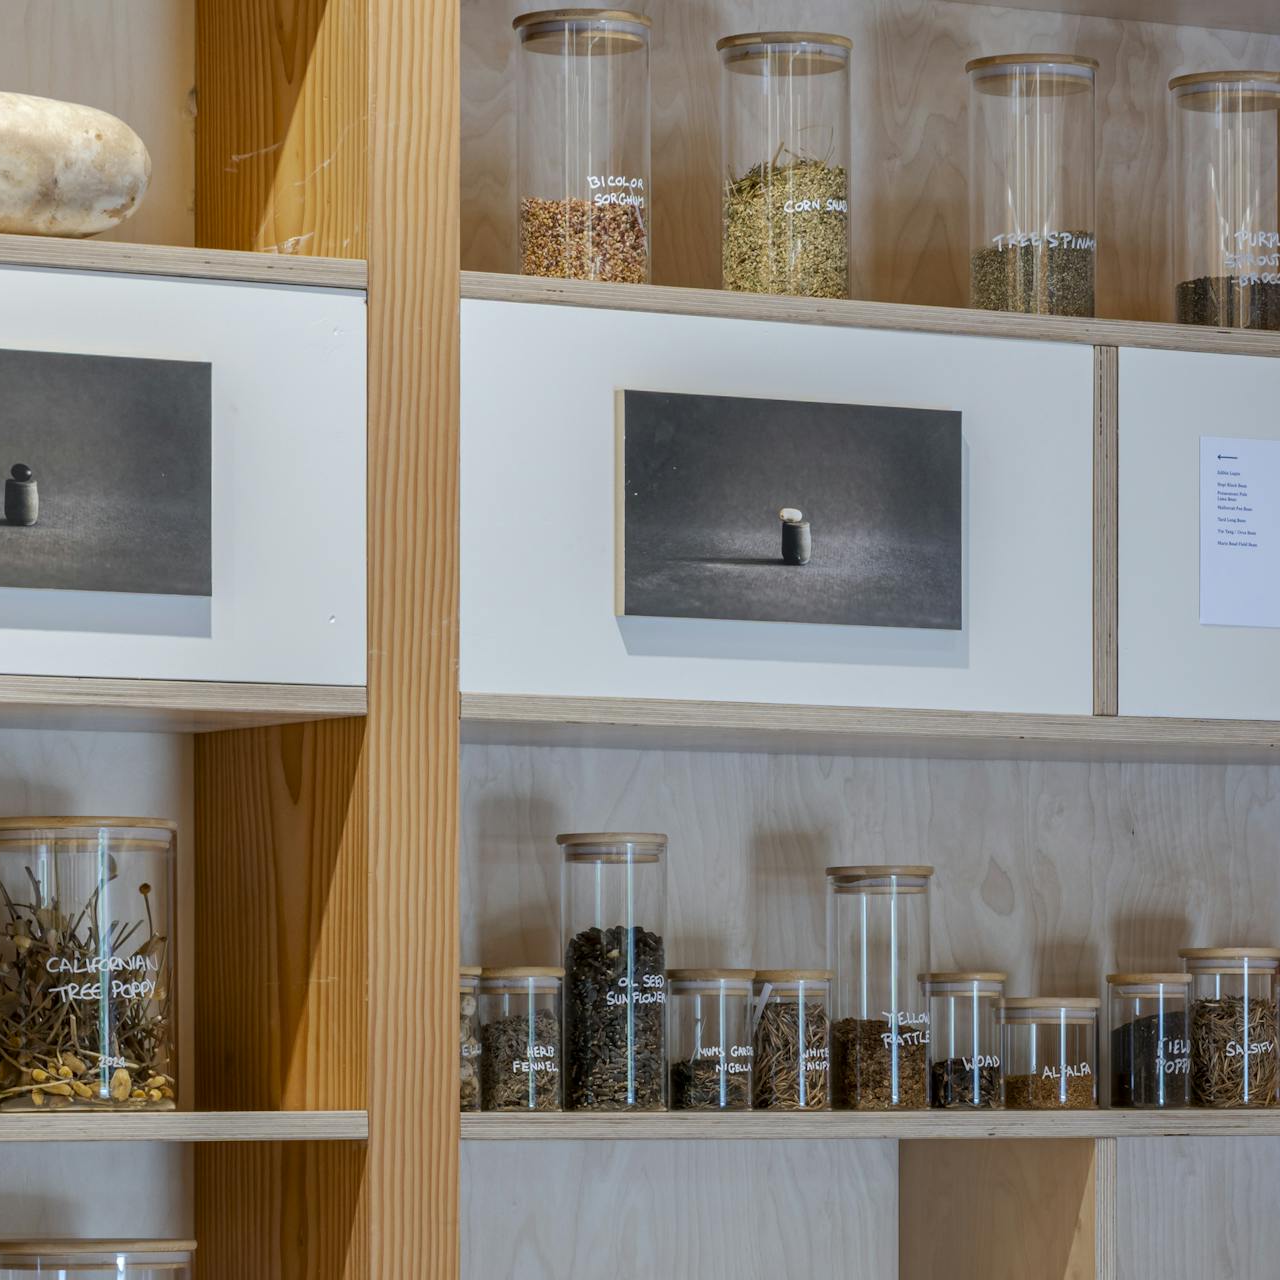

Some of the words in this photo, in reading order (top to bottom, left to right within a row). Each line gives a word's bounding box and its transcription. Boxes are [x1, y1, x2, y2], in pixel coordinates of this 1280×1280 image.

[587, 175, 644, 190] BICOLOR
[784, 200, 819, 213] CORN
[992, 231, 1042, 252] TREE
[46, 954, 159, 974] CALIFORNIAN
[48, 982, 104, 1003] TREE
[111, 979, 156, 999] POPPY
[526, 1046, 555, 1059] HERB
[1225, 1040, 1274, 1057] SALSIFY
[513, 1060, 559, 1073] FENNEL
[962, 1055, 1000, 1071] WOAD
